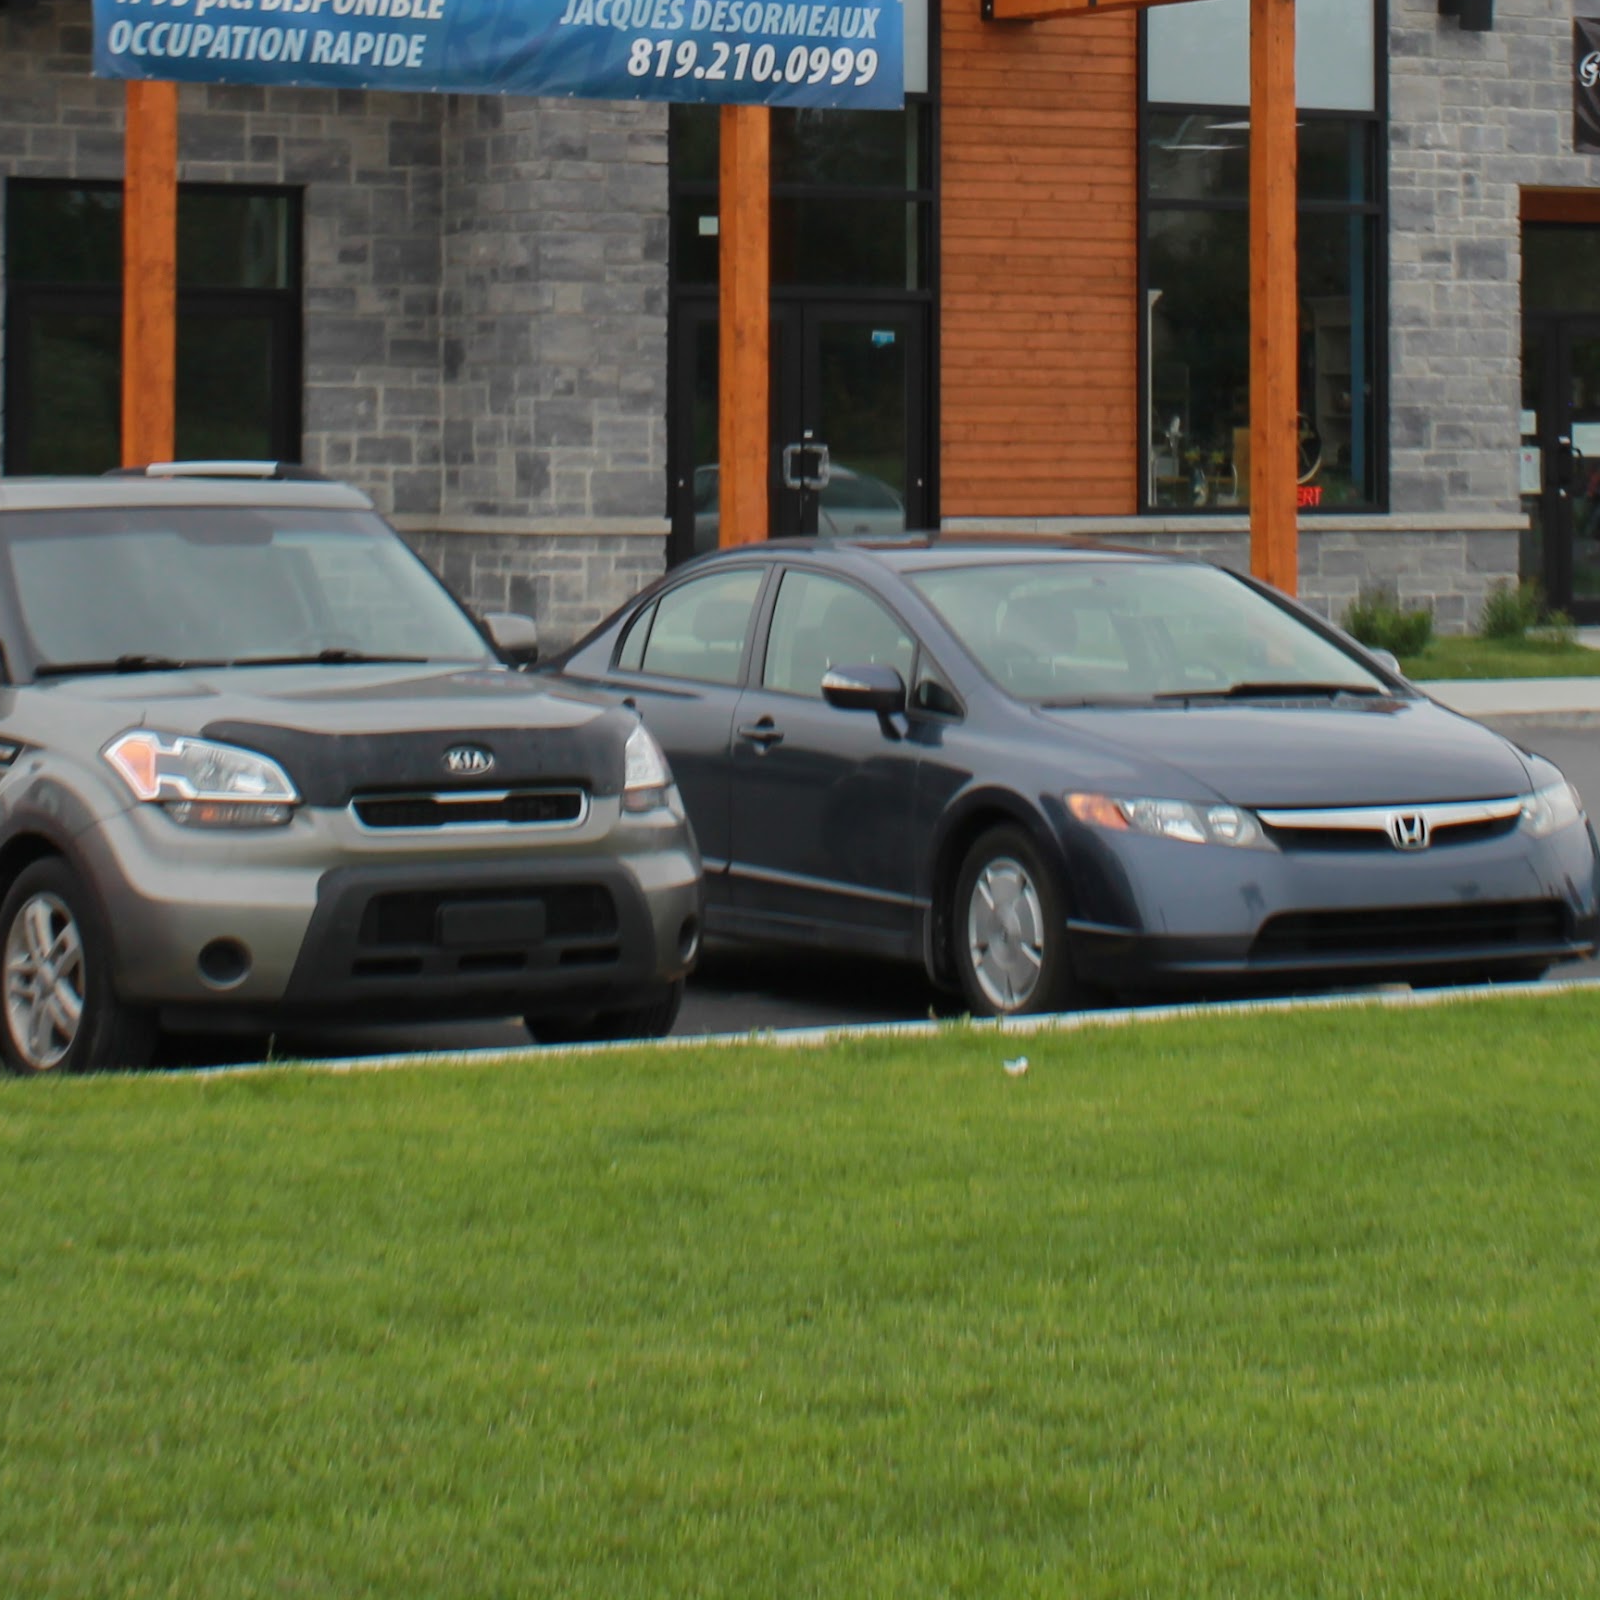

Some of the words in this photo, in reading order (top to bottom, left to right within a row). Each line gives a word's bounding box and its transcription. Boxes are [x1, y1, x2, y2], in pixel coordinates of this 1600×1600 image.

[690, 0, 881, 40] DESORMEAUX
[108, 19, 307, 62] OCCUPATION
[310, 29, 427, 68] RAPIDE
[626, 37, 879, 87] 819.210.0999
[448, 750, 487, 770] KIA
